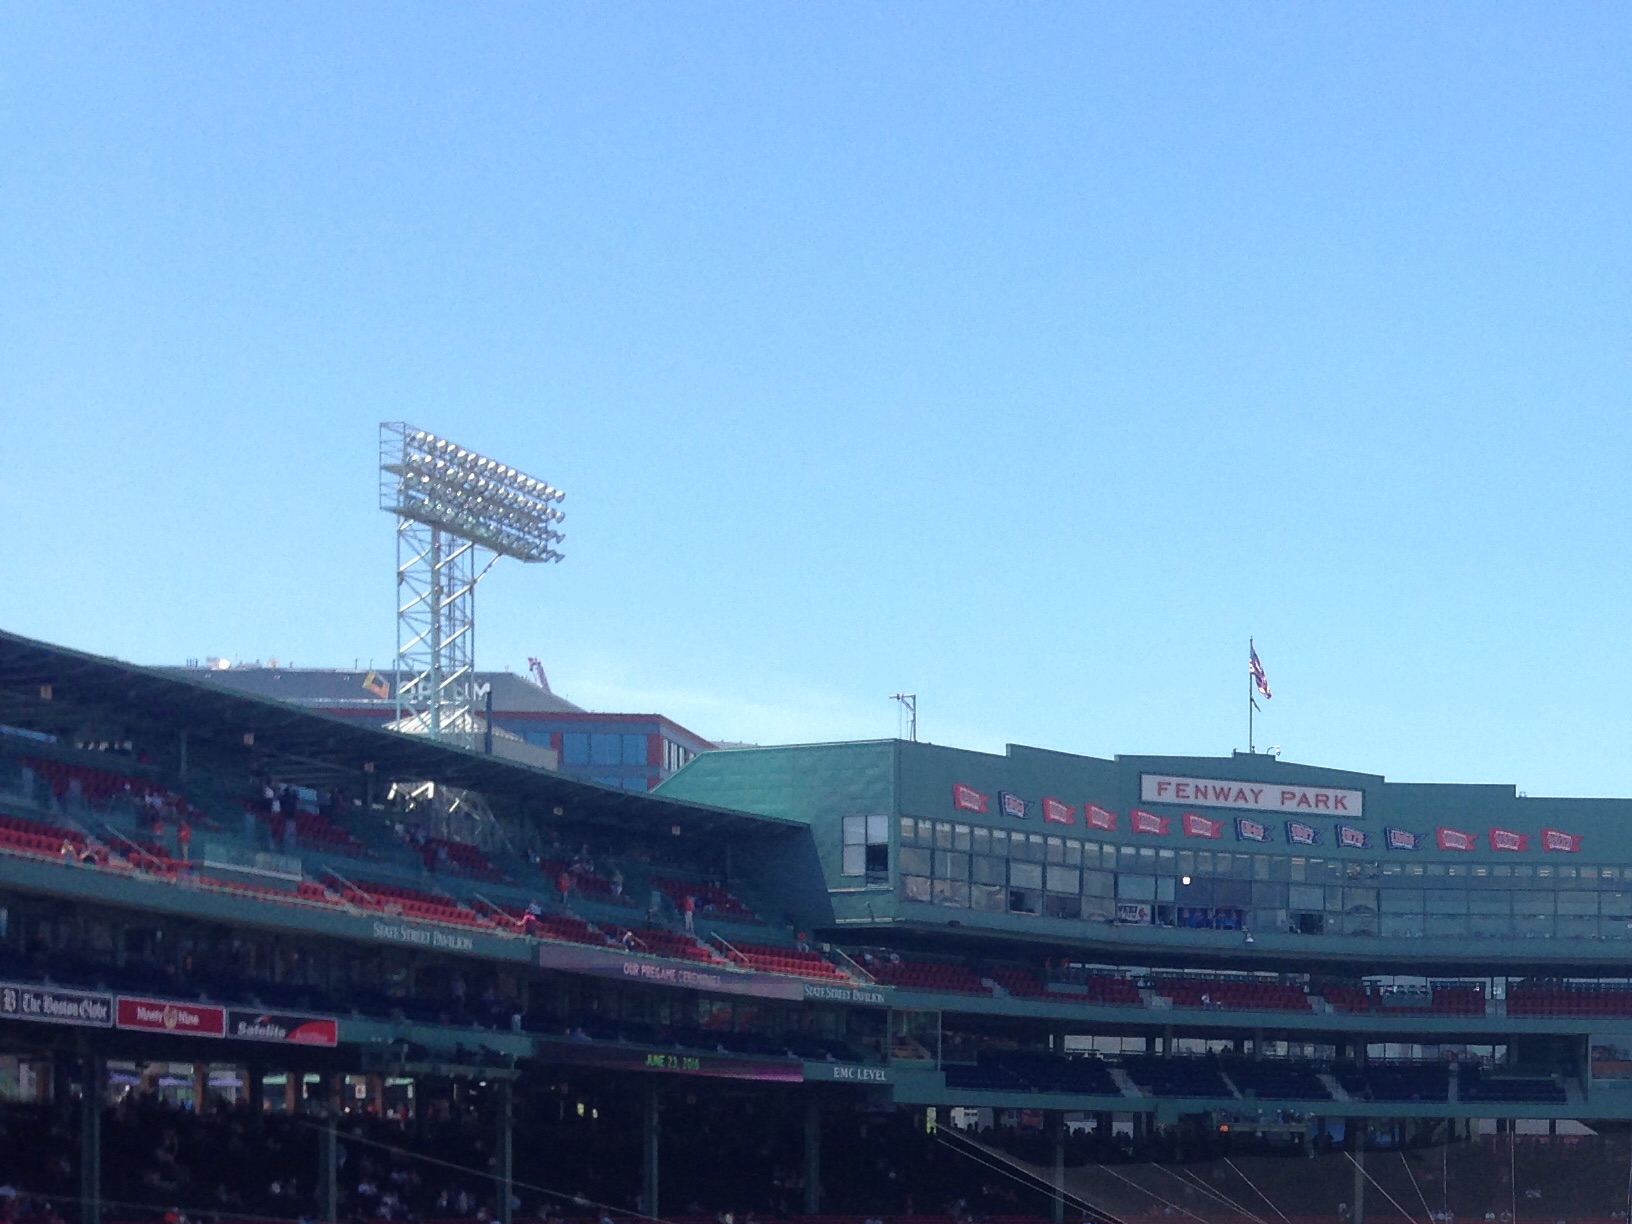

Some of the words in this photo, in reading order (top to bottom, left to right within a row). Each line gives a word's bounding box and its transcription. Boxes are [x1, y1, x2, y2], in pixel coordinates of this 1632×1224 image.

[1157, 782, 1263, 804] FENWAY
[1281, 791, 1347, 811] PARK
[400, 925, 430, 944] STREET
[434, 930, 473, 950] PAVILION
[623, 963, 639, 976] OUR
[805, 986, 826, 997] STATE
[827, 987, 850, 999] STREET
[853, 990, 885, 1002] PAVILION
[645, 1054, 665, 1068] JUNE
[834, 1067, 855, 1079] EMC
[857, 1069, 886, 1081] LEVEL
